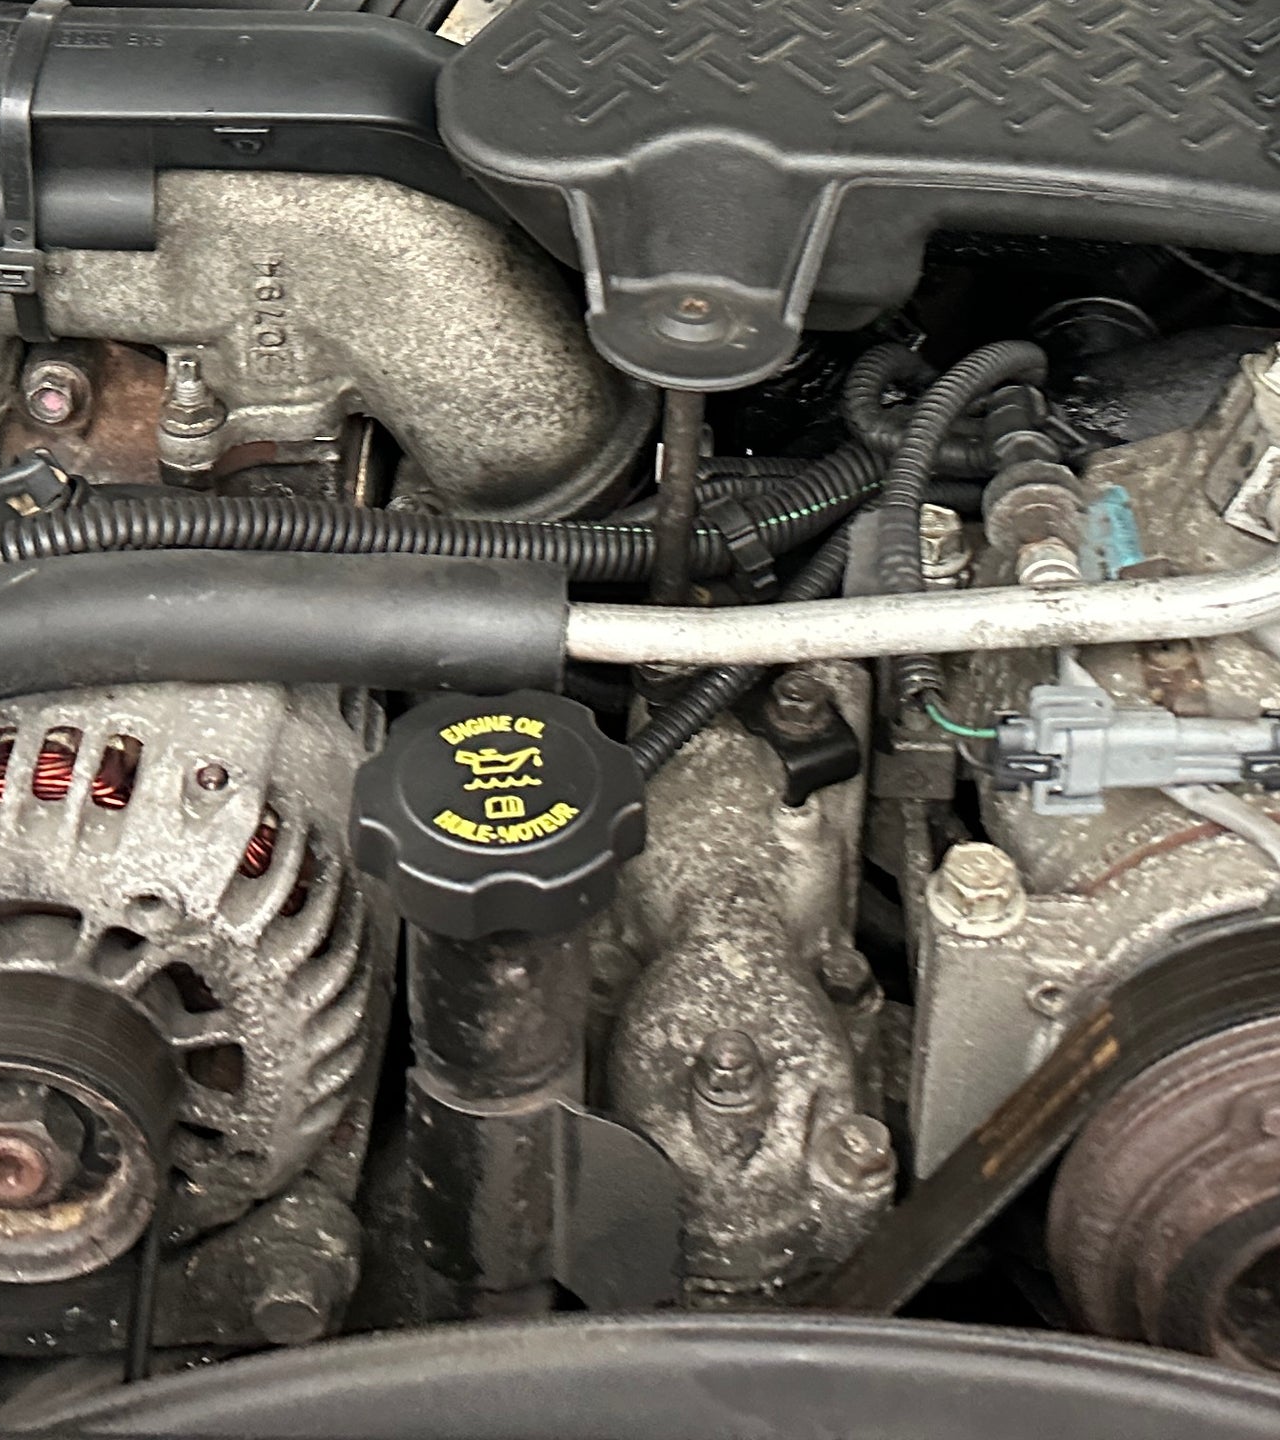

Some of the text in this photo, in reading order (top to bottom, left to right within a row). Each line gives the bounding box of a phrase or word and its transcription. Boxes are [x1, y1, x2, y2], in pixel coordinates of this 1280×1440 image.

[440, 715, 546, 745] ENGINE OIL
[432, 802, 580, 844] HUILE-MOTEUR
